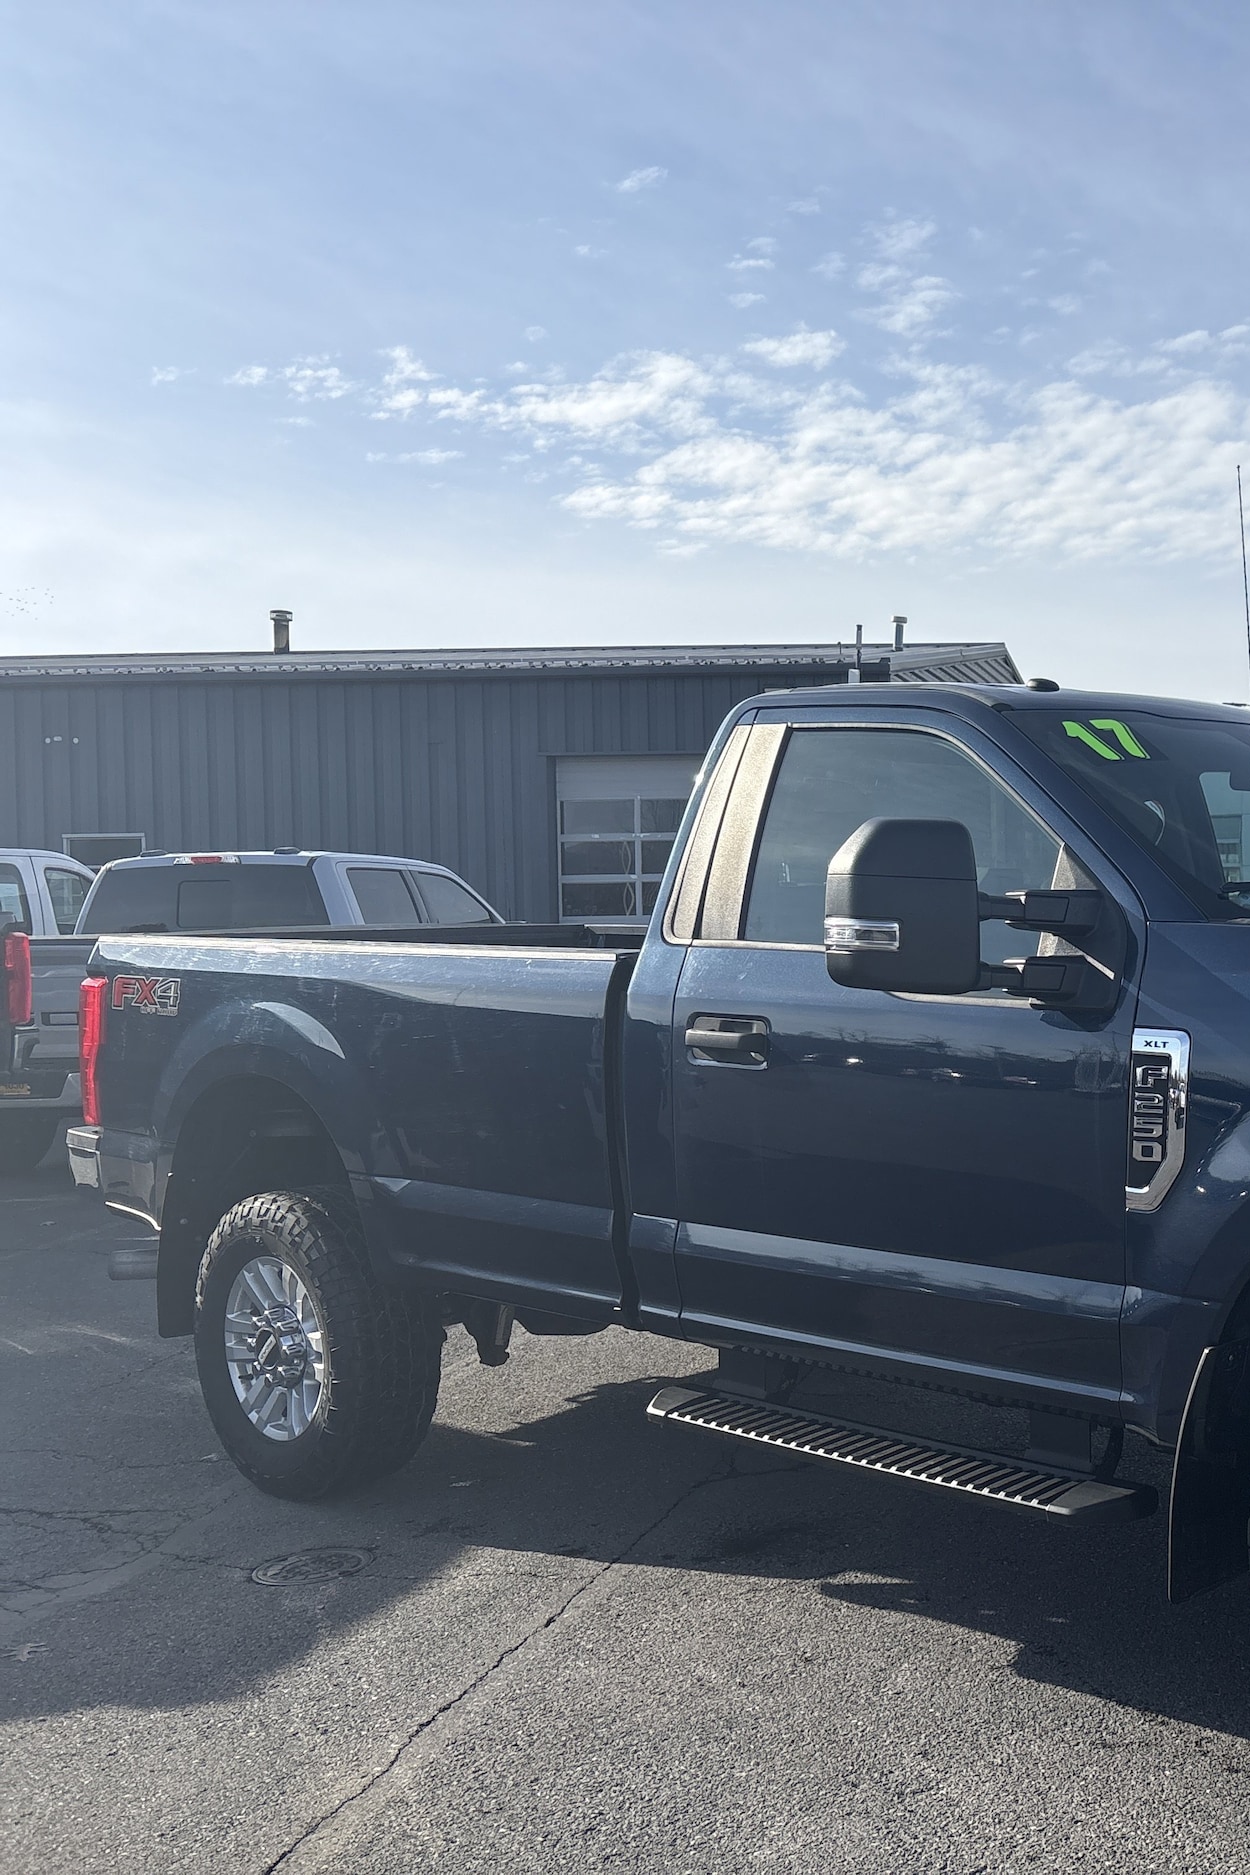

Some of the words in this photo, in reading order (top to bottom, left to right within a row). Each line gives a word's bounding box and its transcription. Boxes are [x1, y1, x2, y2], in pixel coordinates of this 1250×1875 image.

[1062, 719, 1151, 760] 17
[112, 975, 180, 1010] FX4
[1144, 1040, 1169, 1049] XLT
[1132, 1065, 1169, 1162] F250
